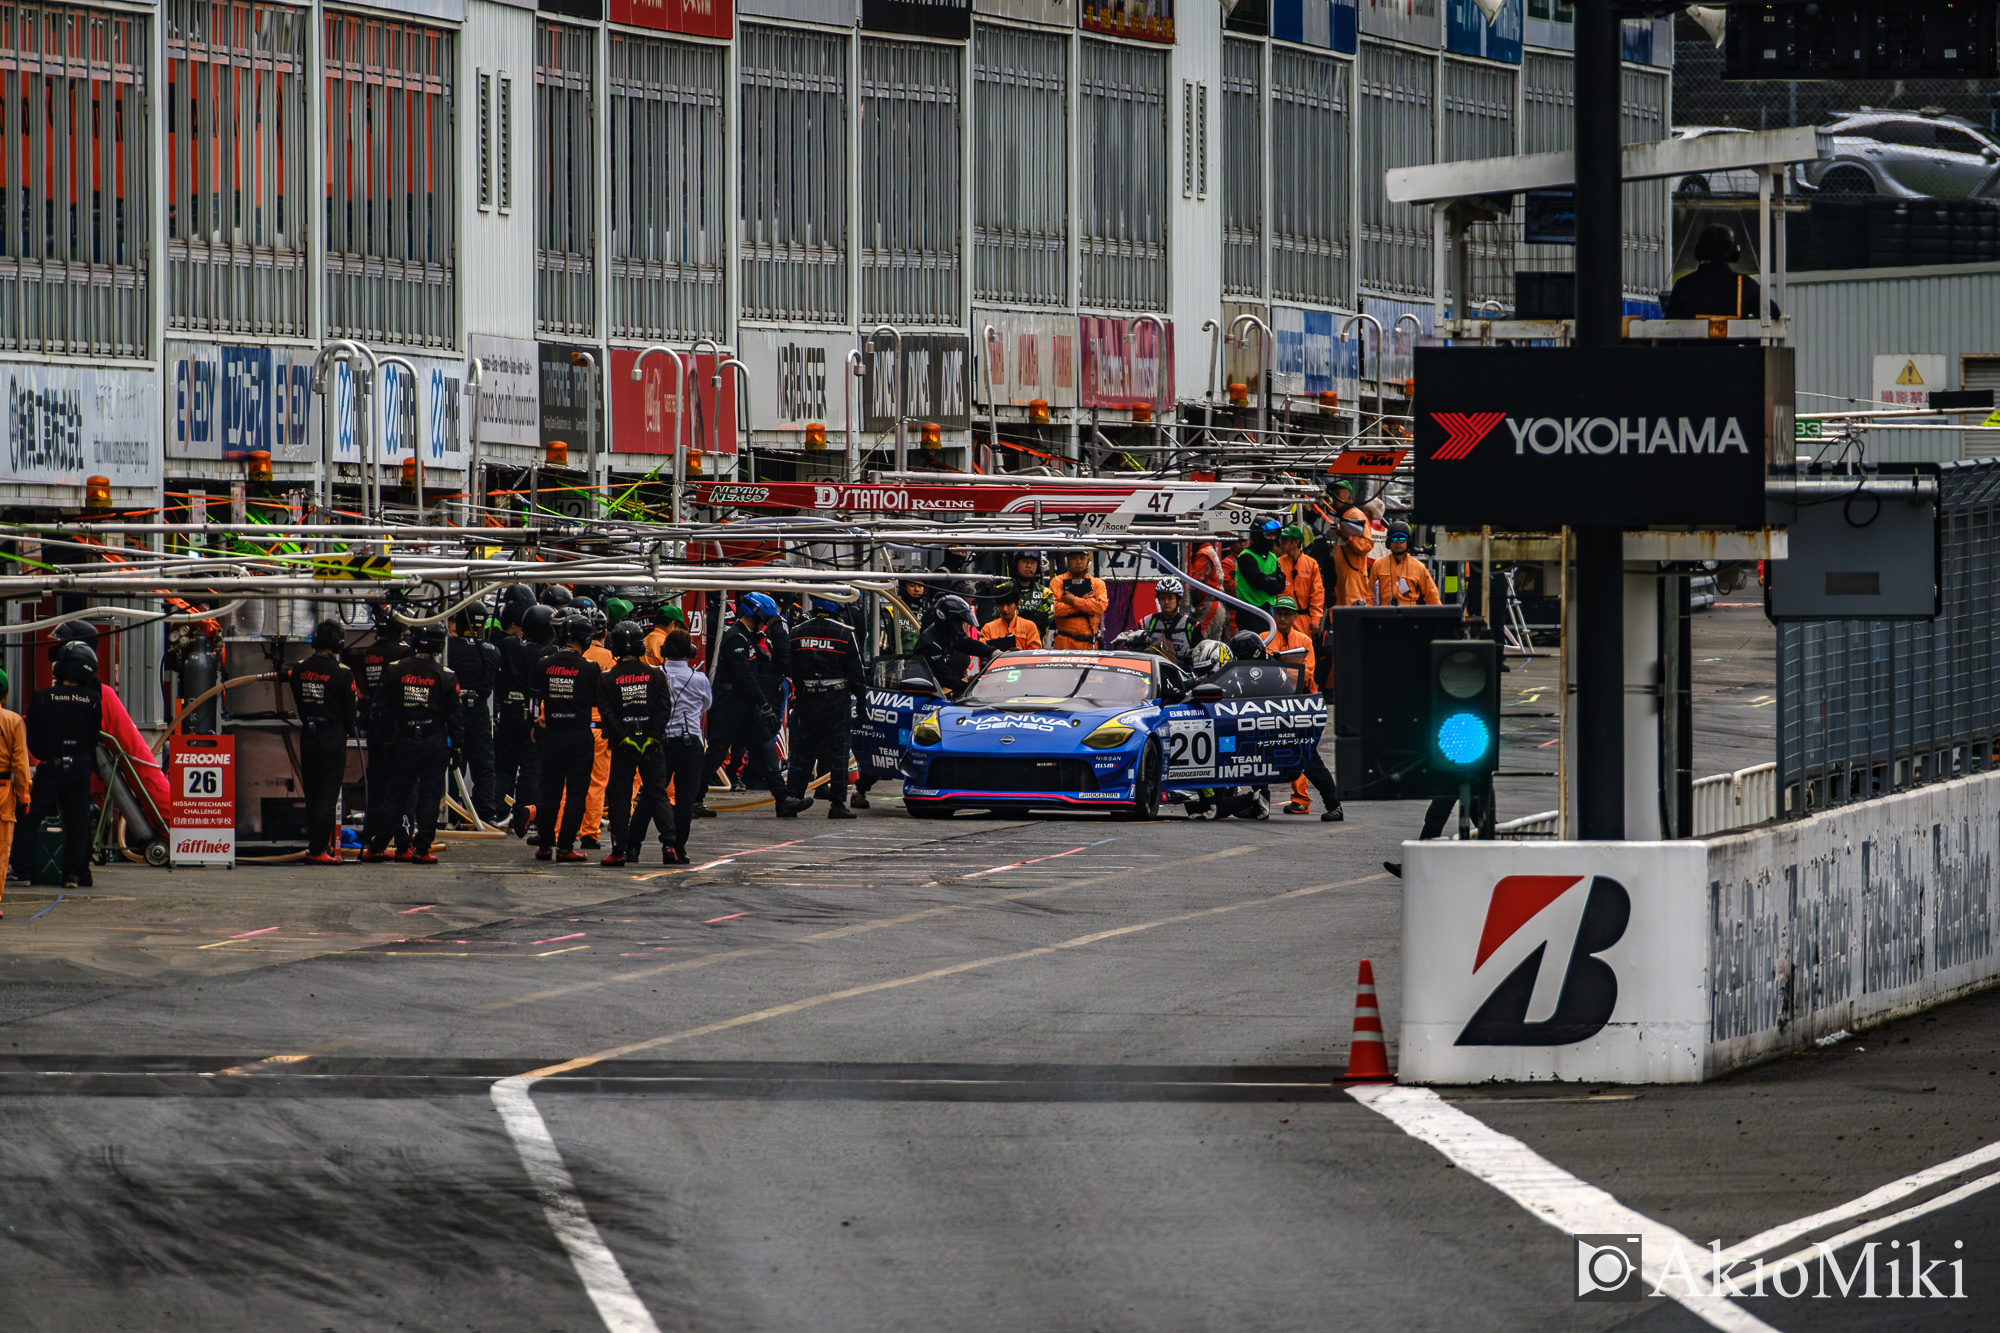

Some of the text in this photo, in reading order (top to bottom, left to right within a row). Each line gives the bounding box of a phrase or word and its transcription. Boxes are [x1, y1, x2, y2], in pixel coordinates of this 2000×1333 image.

[178, 355, 216, 450] EXEDY
[228, 357, 264, 447] エクセディ
[277, 360, 313, 450] EXEDY
[1505, 416, 1749, 455] YOKOHAMA
[1356, 453, 1394, 466] KTM
[709, 486, 769, 503] NEXUS
[1147, 492, 1174, 512] 47
[1087, 513, 1107, 528] 97
[1229, 511, 1252, 524] 98
[800, 639, 835, 650] MPUL
[1053, 656, 1100, 664] ENEOS
[991, 665, 1017, 673] IMPUL
[1116, 667, 1144, 677] IMPUL
[1006, 670, 1021, 682] 5
[404, 685, 429, 693] NISSAN
[621, 684, 647, 692] NISSAN
[50, 693, 70, 701] Team
[1214, 698, 1327, 716] NANIW
[962, 714, 1072, 728] NANIWA
[975, 720, 1054, 732] DENSO
[1204, 721, 1212, 729] Z
[879, 747, 900, 757] TEAM
[1169, 731, 1212, 766] 20
[175, 753, 230, 764] ZEROONE
[1231, 755, 1262, 764] TEAM
[1169, 770, 1212, 778] BRIDGESTONE
[1219, 764, 1280, 778] IMPUL
[189, 771, 217, 793] 26
[173, 817, 232, 825] 日産自動車大学校
